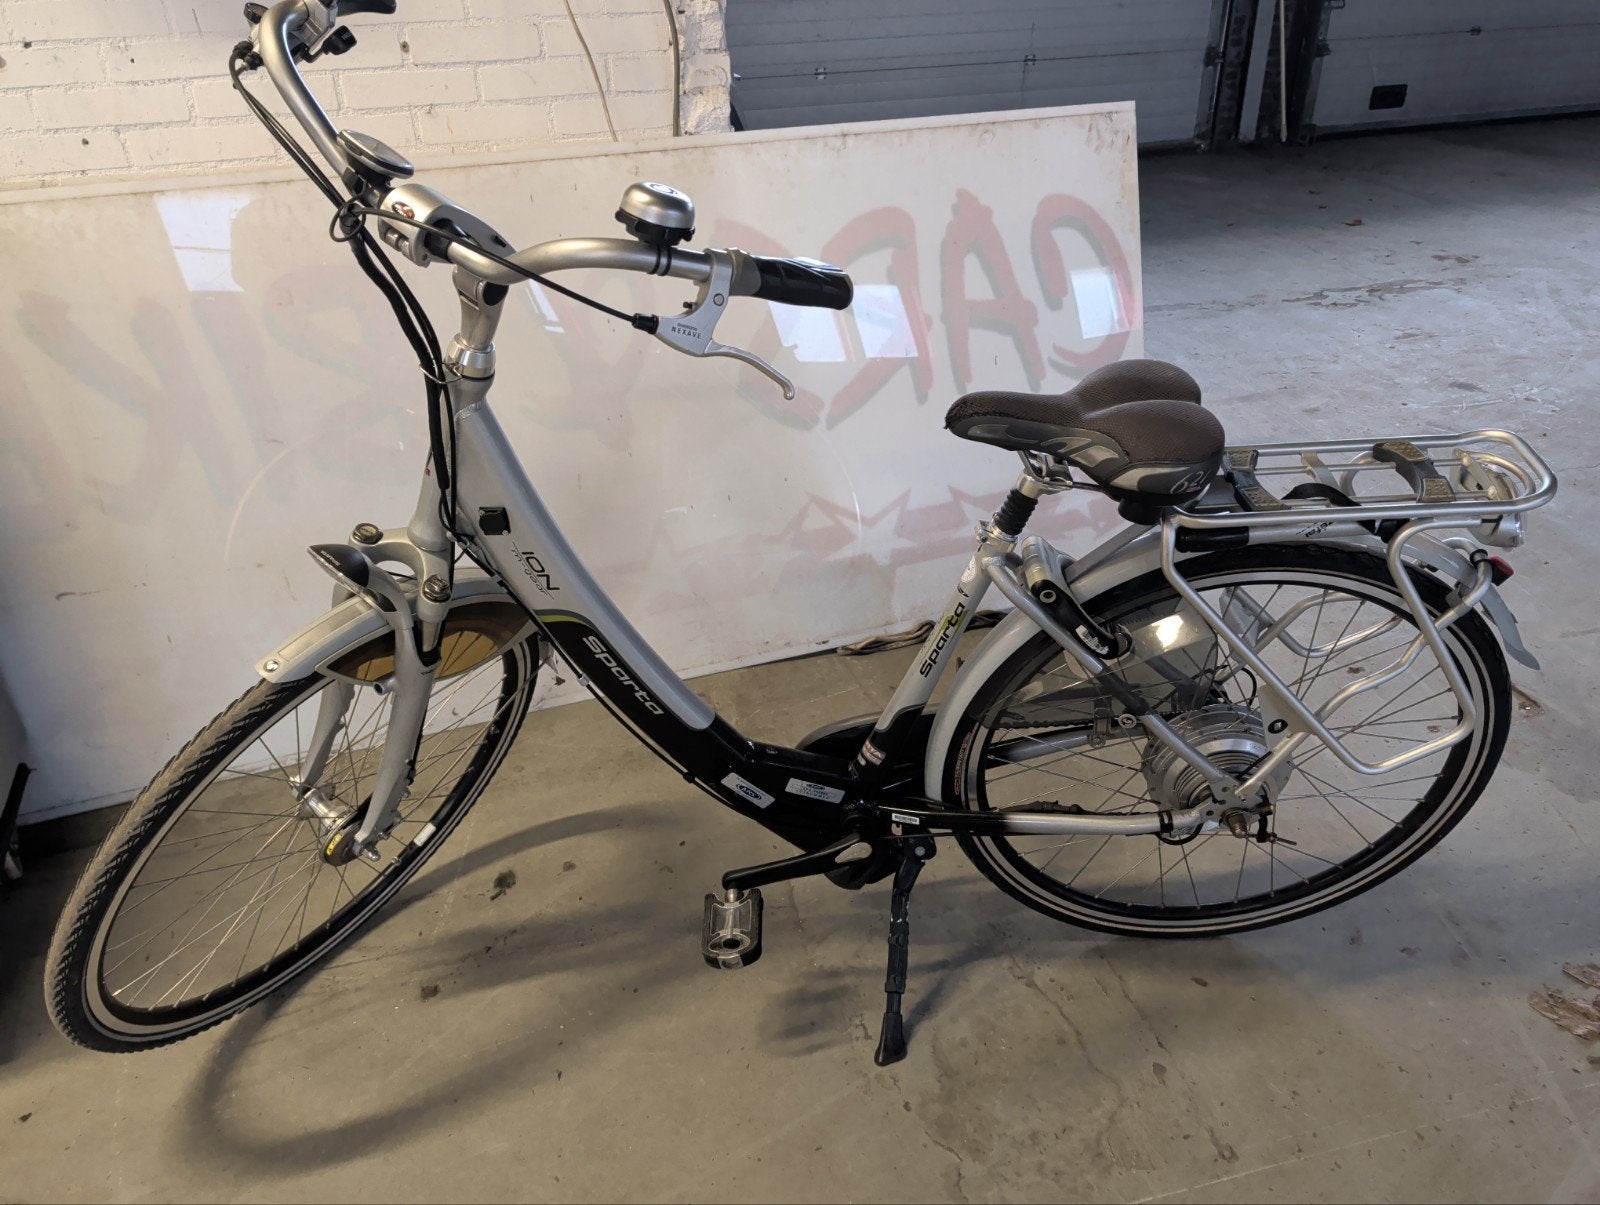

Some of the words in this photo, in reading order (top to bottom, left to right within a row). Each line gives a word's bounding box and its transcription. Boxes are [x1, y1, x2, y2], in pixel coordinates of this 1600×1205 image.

[671, 325, 702, 340] NEXAVE
[521, 551, 561, 591] ION
[919, 601, 966, 679] Sparta
[582, 634, 665, 716] Sparta
